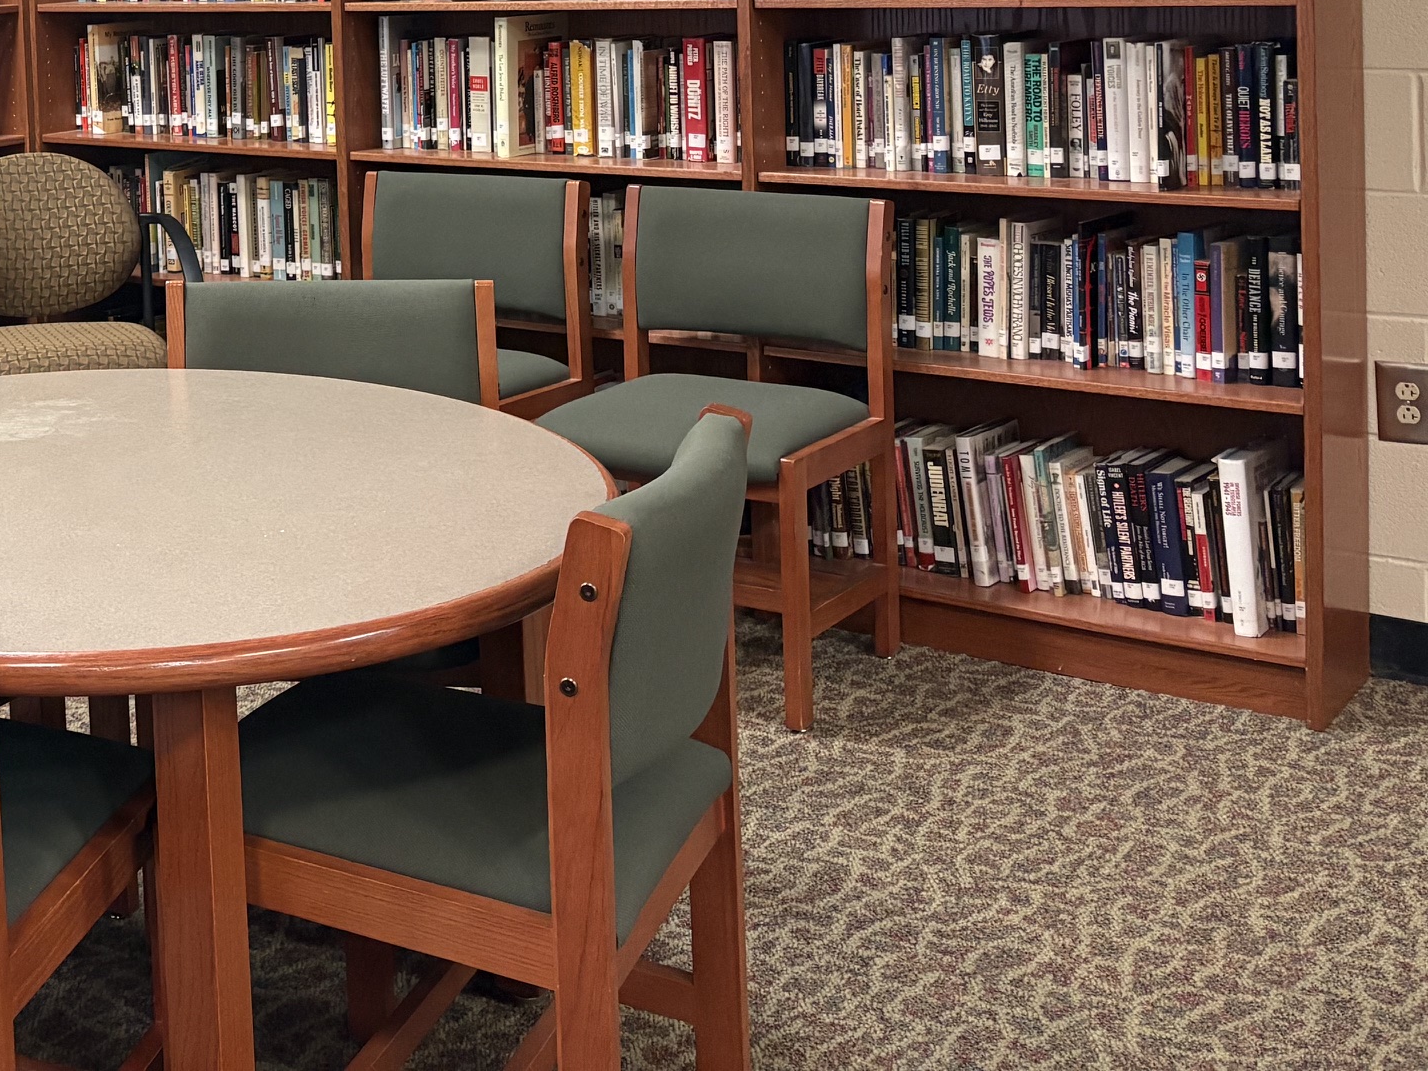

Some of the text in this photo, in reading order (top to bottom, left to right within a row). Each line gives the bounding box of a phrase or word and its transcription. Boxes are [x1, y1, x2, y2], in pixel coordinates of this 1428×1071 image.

[550, 61, 561, 123] ALFRED ROSENBERG
[599, 58, 611, 123] TIME WAR
[686, 79, 702, 120] DÖNITZ
[977, 83, 1000, 97] Etty
[1025, 58, 1033, 123] NUREMBERG
[1071, 93, 1082, 132] FOLEY
[1238, 86, 1251, 149] QUIET HEROES
[1259, 98, 1271, 132] NOT AS
[946, 250, 957, 316] Jack and Rochelle
[982, 255, 996, 324] THE POPE'S JEWS
[1012, 243, 1024, 311] CHOICES VICHY
[1249, 268, 1262, 313] DEFIANCE
[1127, 291, 1139, 334] The Pianist
[1181, 282, 1191, 342] The Other Chair
[1277, 303, 1287, 336] Courage
[926, 460, 949, 528] JUDENRAT
[959, 450, 970, 481] TOMI
[1095, 469, 1112, 528] Signs Life
[1112, 491, 1135, 581] HITLER'S SILENT PARTNERS
